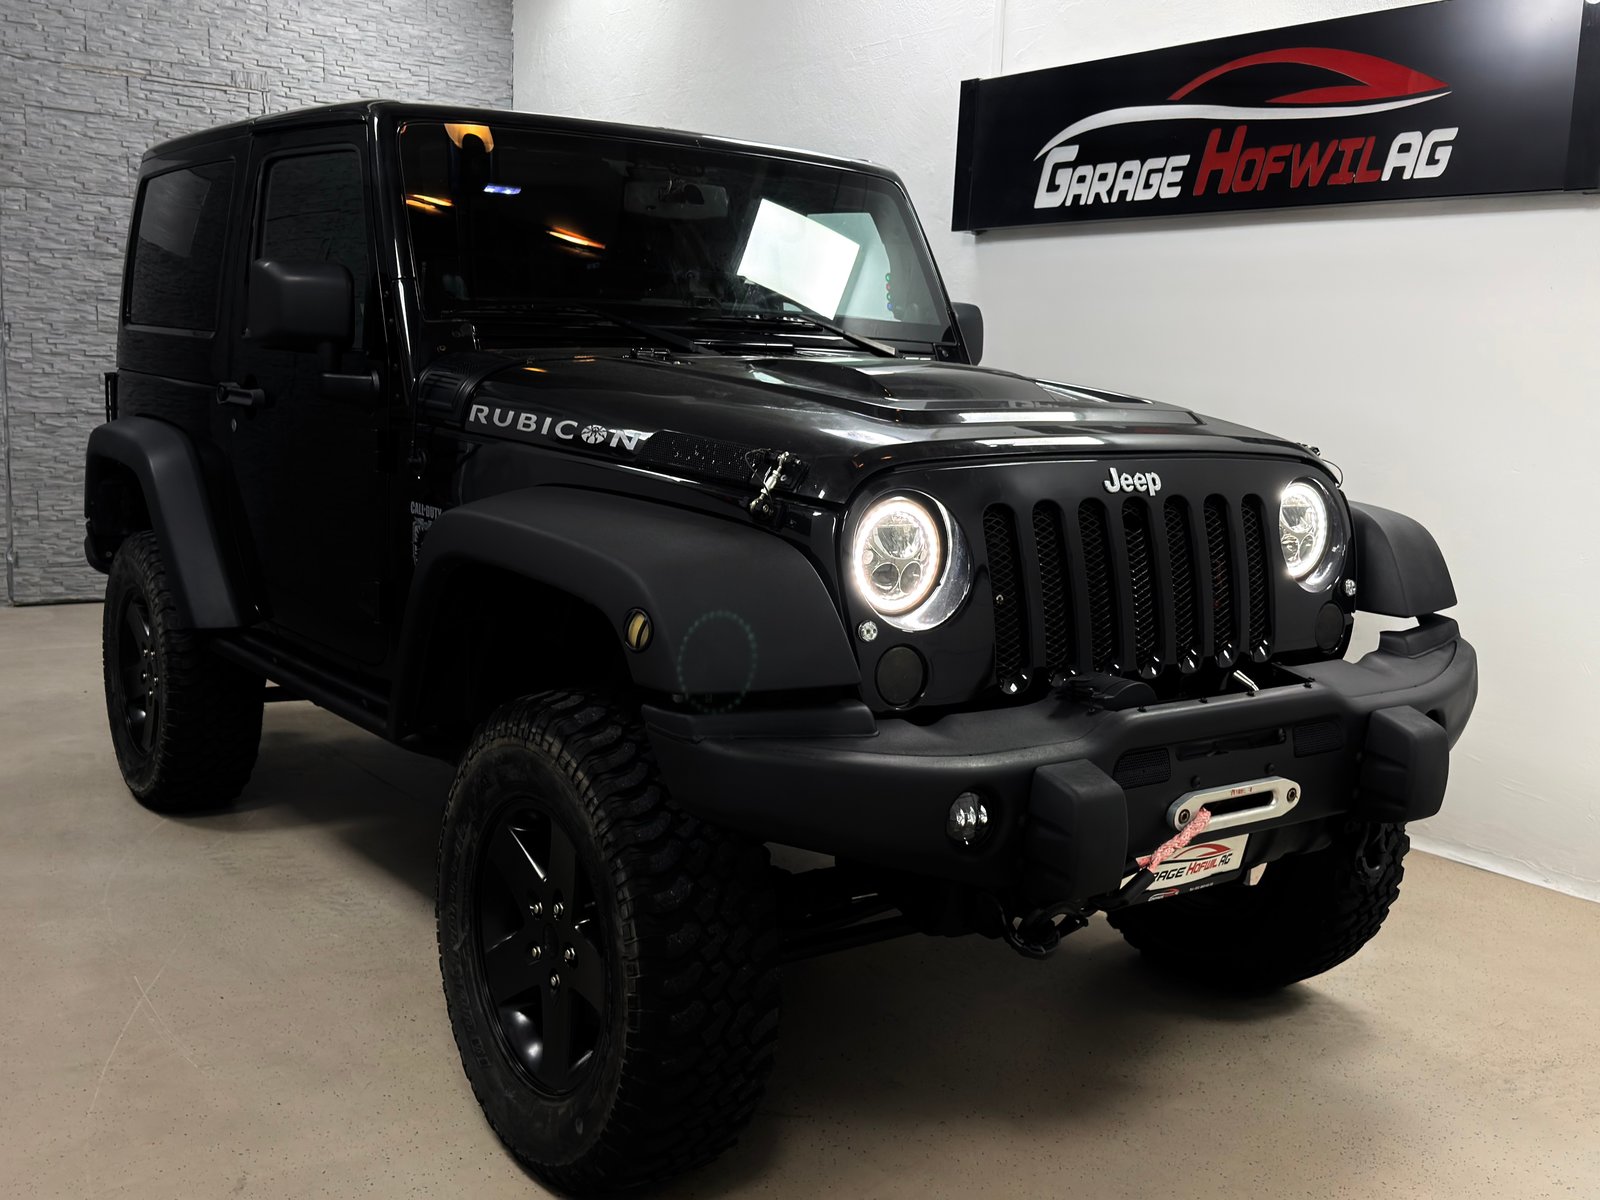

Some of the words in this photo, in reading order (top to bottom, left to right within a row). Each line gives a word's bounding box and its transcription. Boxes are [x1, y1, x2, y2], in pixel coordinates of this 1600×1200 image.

[1034, 144, 1190, 209] GARAGE
[1193, 125, 1382, 196] HOFWIL
[1381, 127, 1459, 181] AG
[468, 404, 640, 450] RUBICON
[1103, 467, 1162, 496] Jeep
